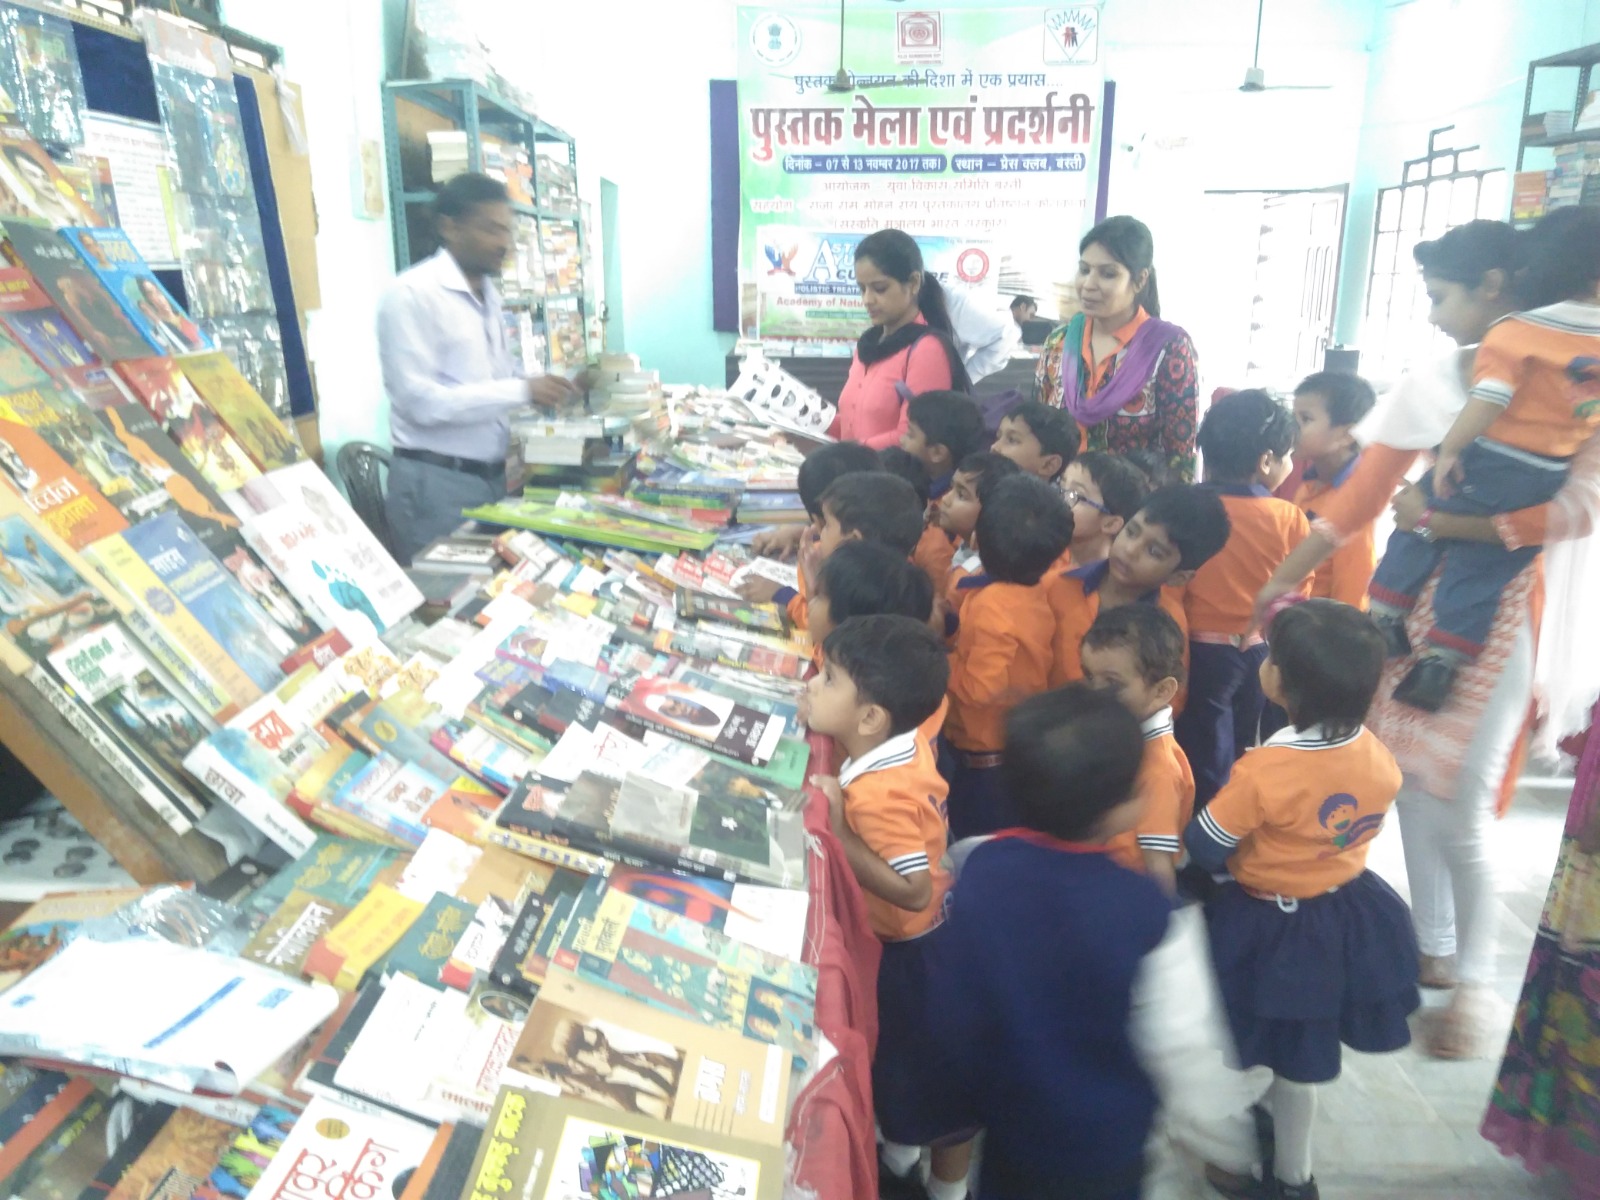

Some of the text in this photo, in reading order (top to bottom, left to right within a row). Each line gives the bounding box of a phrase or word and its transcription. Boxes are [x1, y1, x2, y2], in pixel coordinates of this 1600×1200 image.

[925, 69, 955, 88] दिशा
[961, 68, 973, 87] में
[979, 74, 1002, 88] एक
[750, 91, 1095, 160] पुस्तक मेला एवं प्रदर्शनी
[784, 157, 813, 171] दिनांक
[826, 157, 838, 171] 07
[841, 155, 850, 171] से
[853, 157, 864, 171] 13
[866, 157, 893, 171] नवम्बर
[895, 157, 919, 171] 2017
[955, 157, 983, 171] स्थान
[1000, 155, 1018, 171] प्रेस
[1056, 153, 1083, 171] बस्ती
[776, 296, 823, 308] Academy
[826, 297, 836, 307] of
